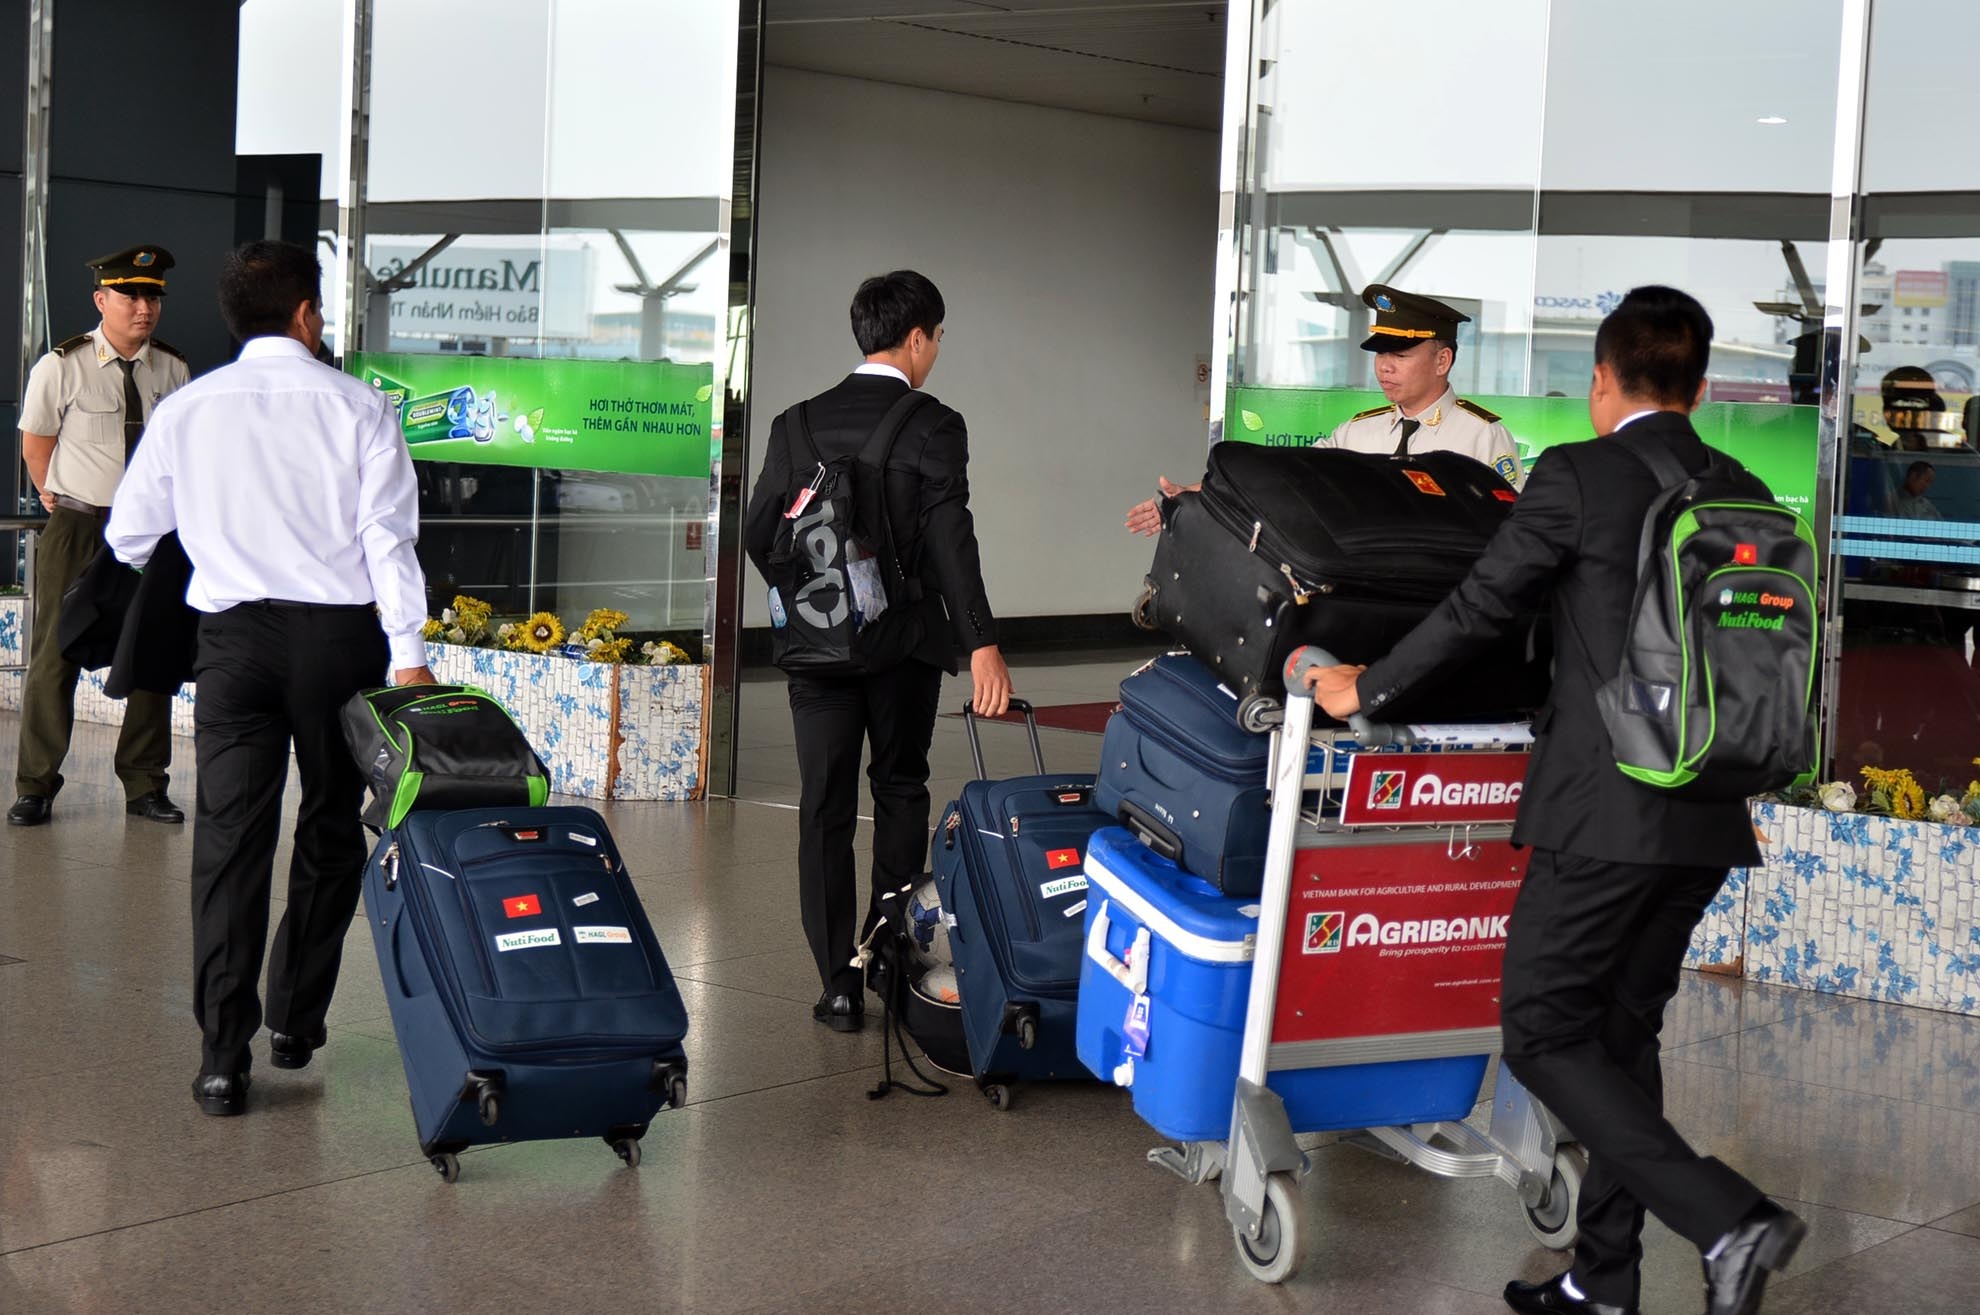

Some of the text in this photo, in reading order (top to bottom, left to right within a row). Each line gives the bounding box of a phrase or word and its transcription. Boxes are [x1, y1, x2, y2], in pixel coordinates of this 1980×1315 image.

[590, 397, 695, 418] HƠI THỞ THƠM MÁT,
[582, 415, 612, 431] THÊM
[642, 420, 674, 434] NHAU
[676, 421, 702, 436] HƠN
[1733, 591, 1795, 611] HAGL Group
[1717, 611, 1785, 631] NutiFood
[1302, 879, 1522, 899] VIETNAM BANK FOR AGRICULTURE AND RURAL DEVELOPMENT
[1346, 913, 1511, 947] AGRIBANK
[502, 933, 555, 948] NutiFood
[1379, 942, 1507, 958] Bring prosperity to customers
